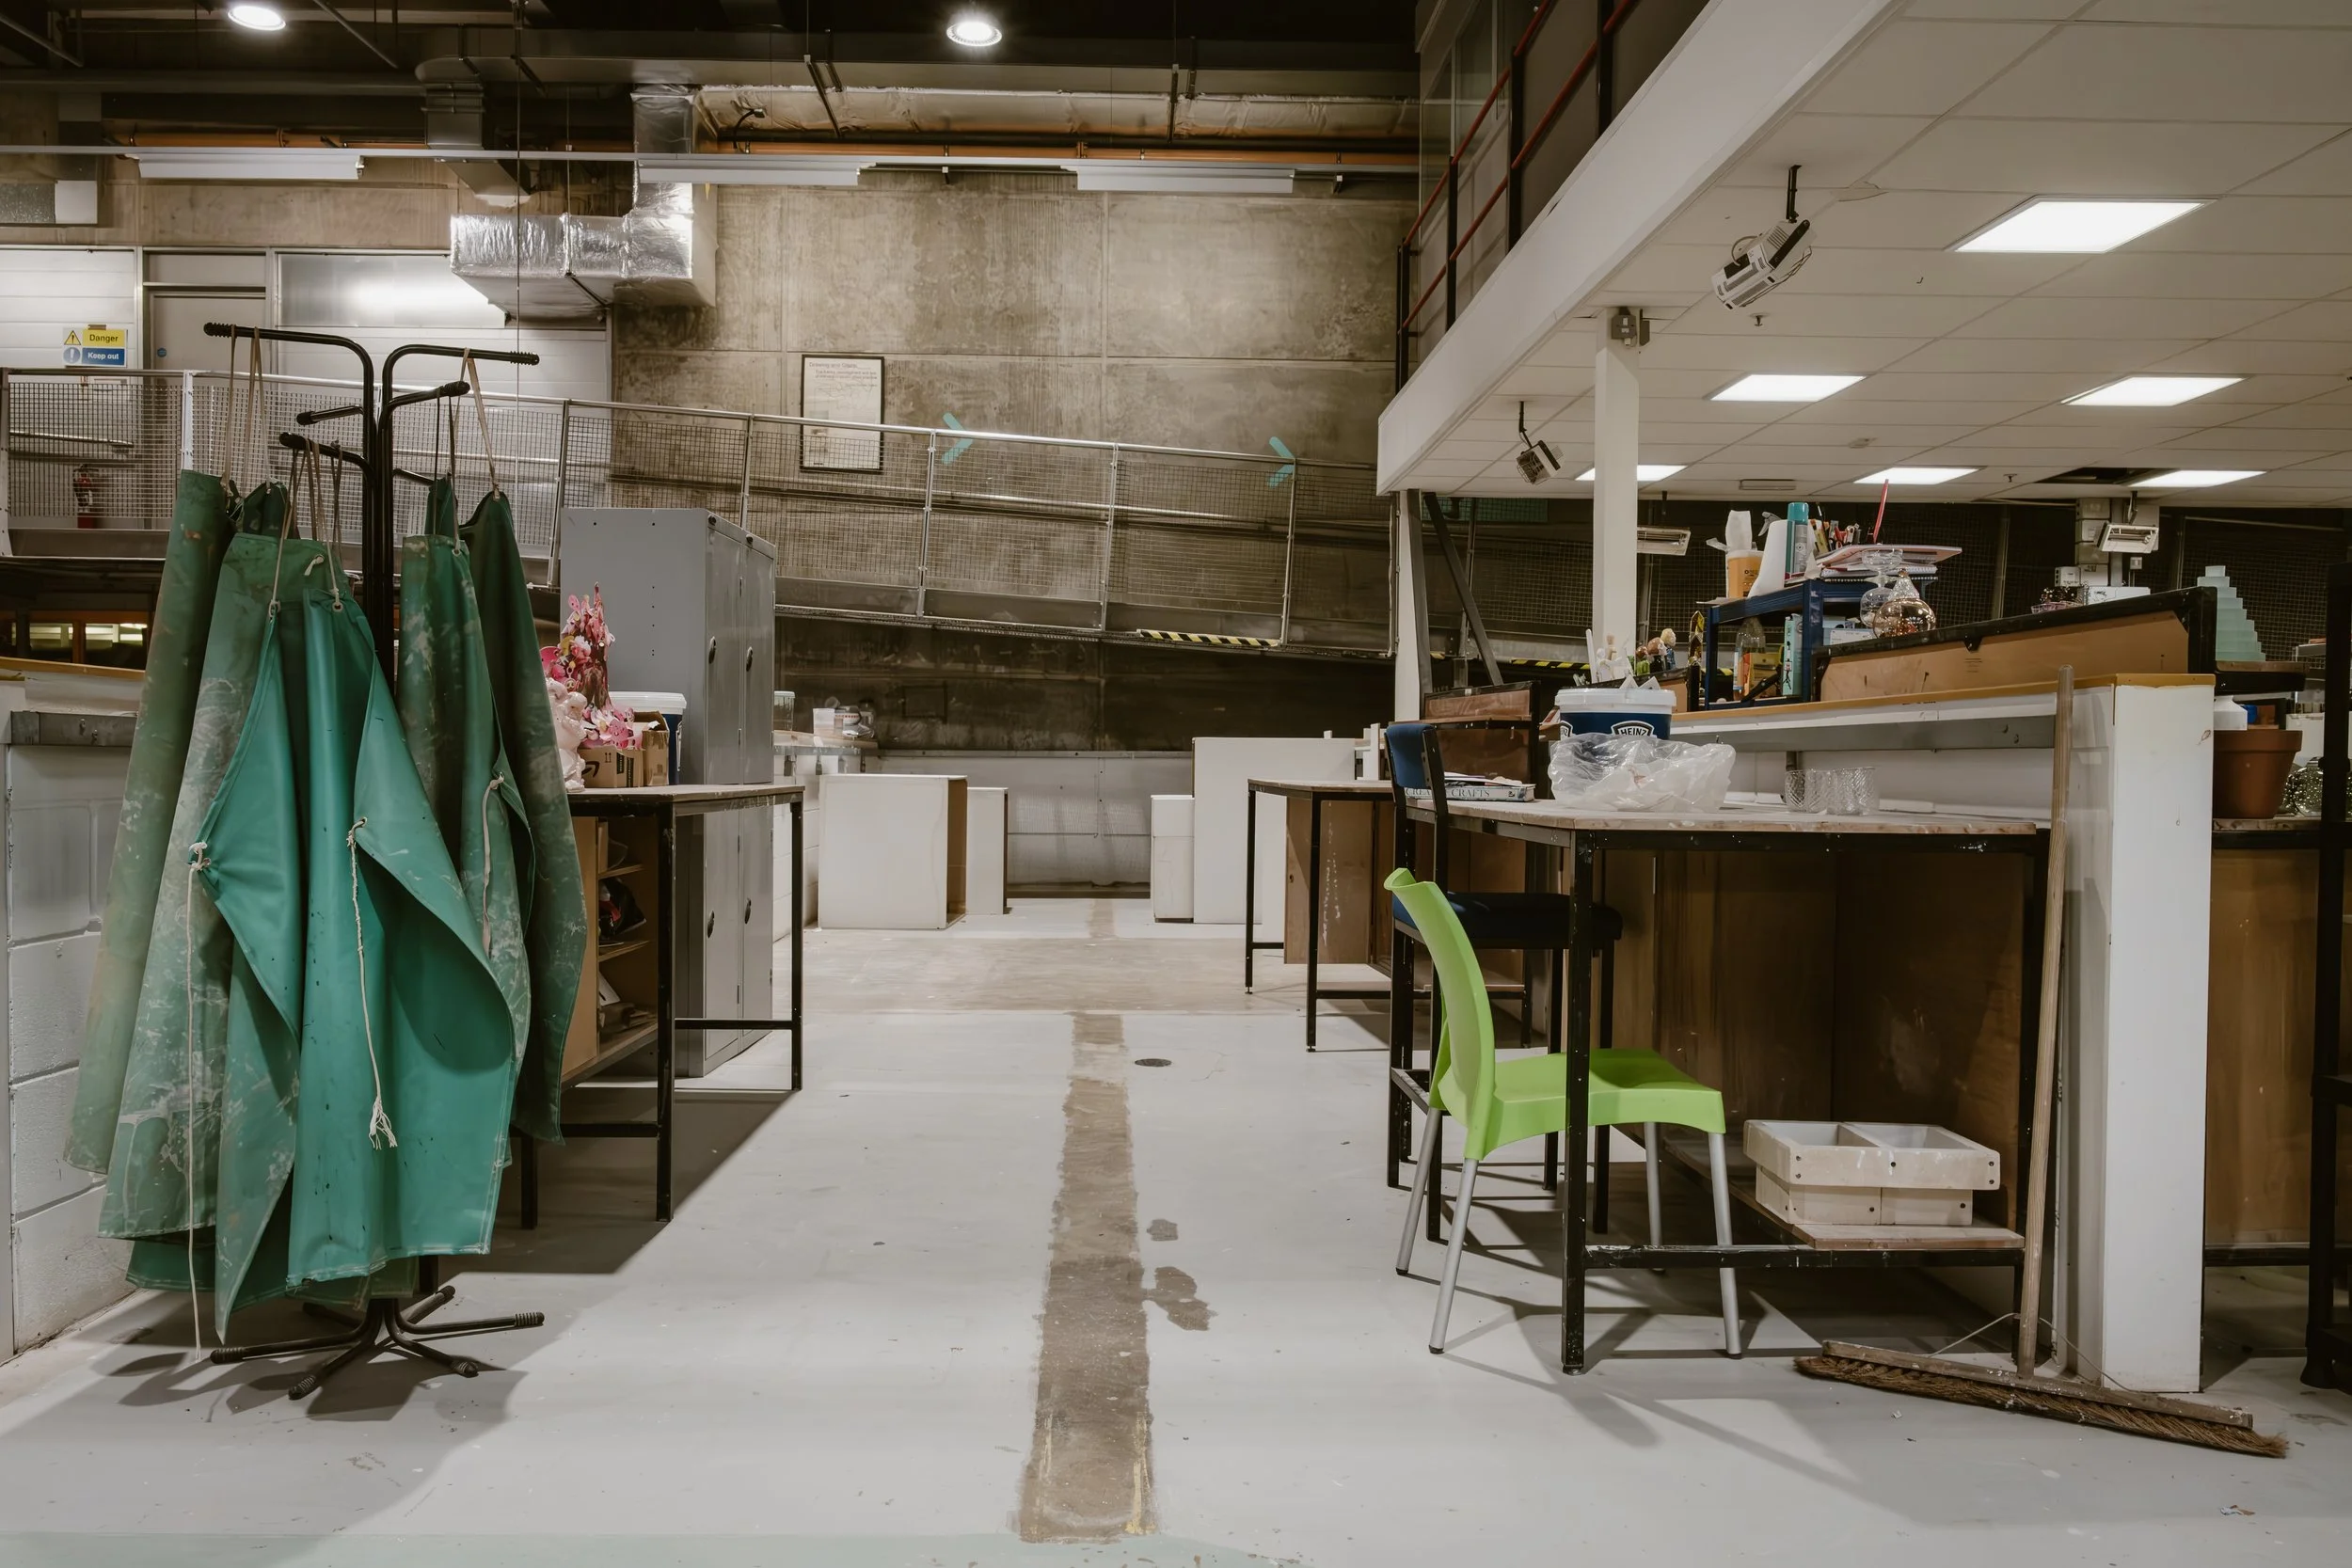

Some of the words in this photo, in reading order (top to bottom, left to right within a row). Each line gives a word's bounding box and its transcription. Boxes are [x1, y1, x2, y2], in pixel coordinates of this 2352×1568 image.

[89, 334, 119, 343] Danger
[87, 352, 106, 360] Keep
[1620, 727, 1647, 736] HEINZ
[1451, 788, 1490, 798] CRAFTS
